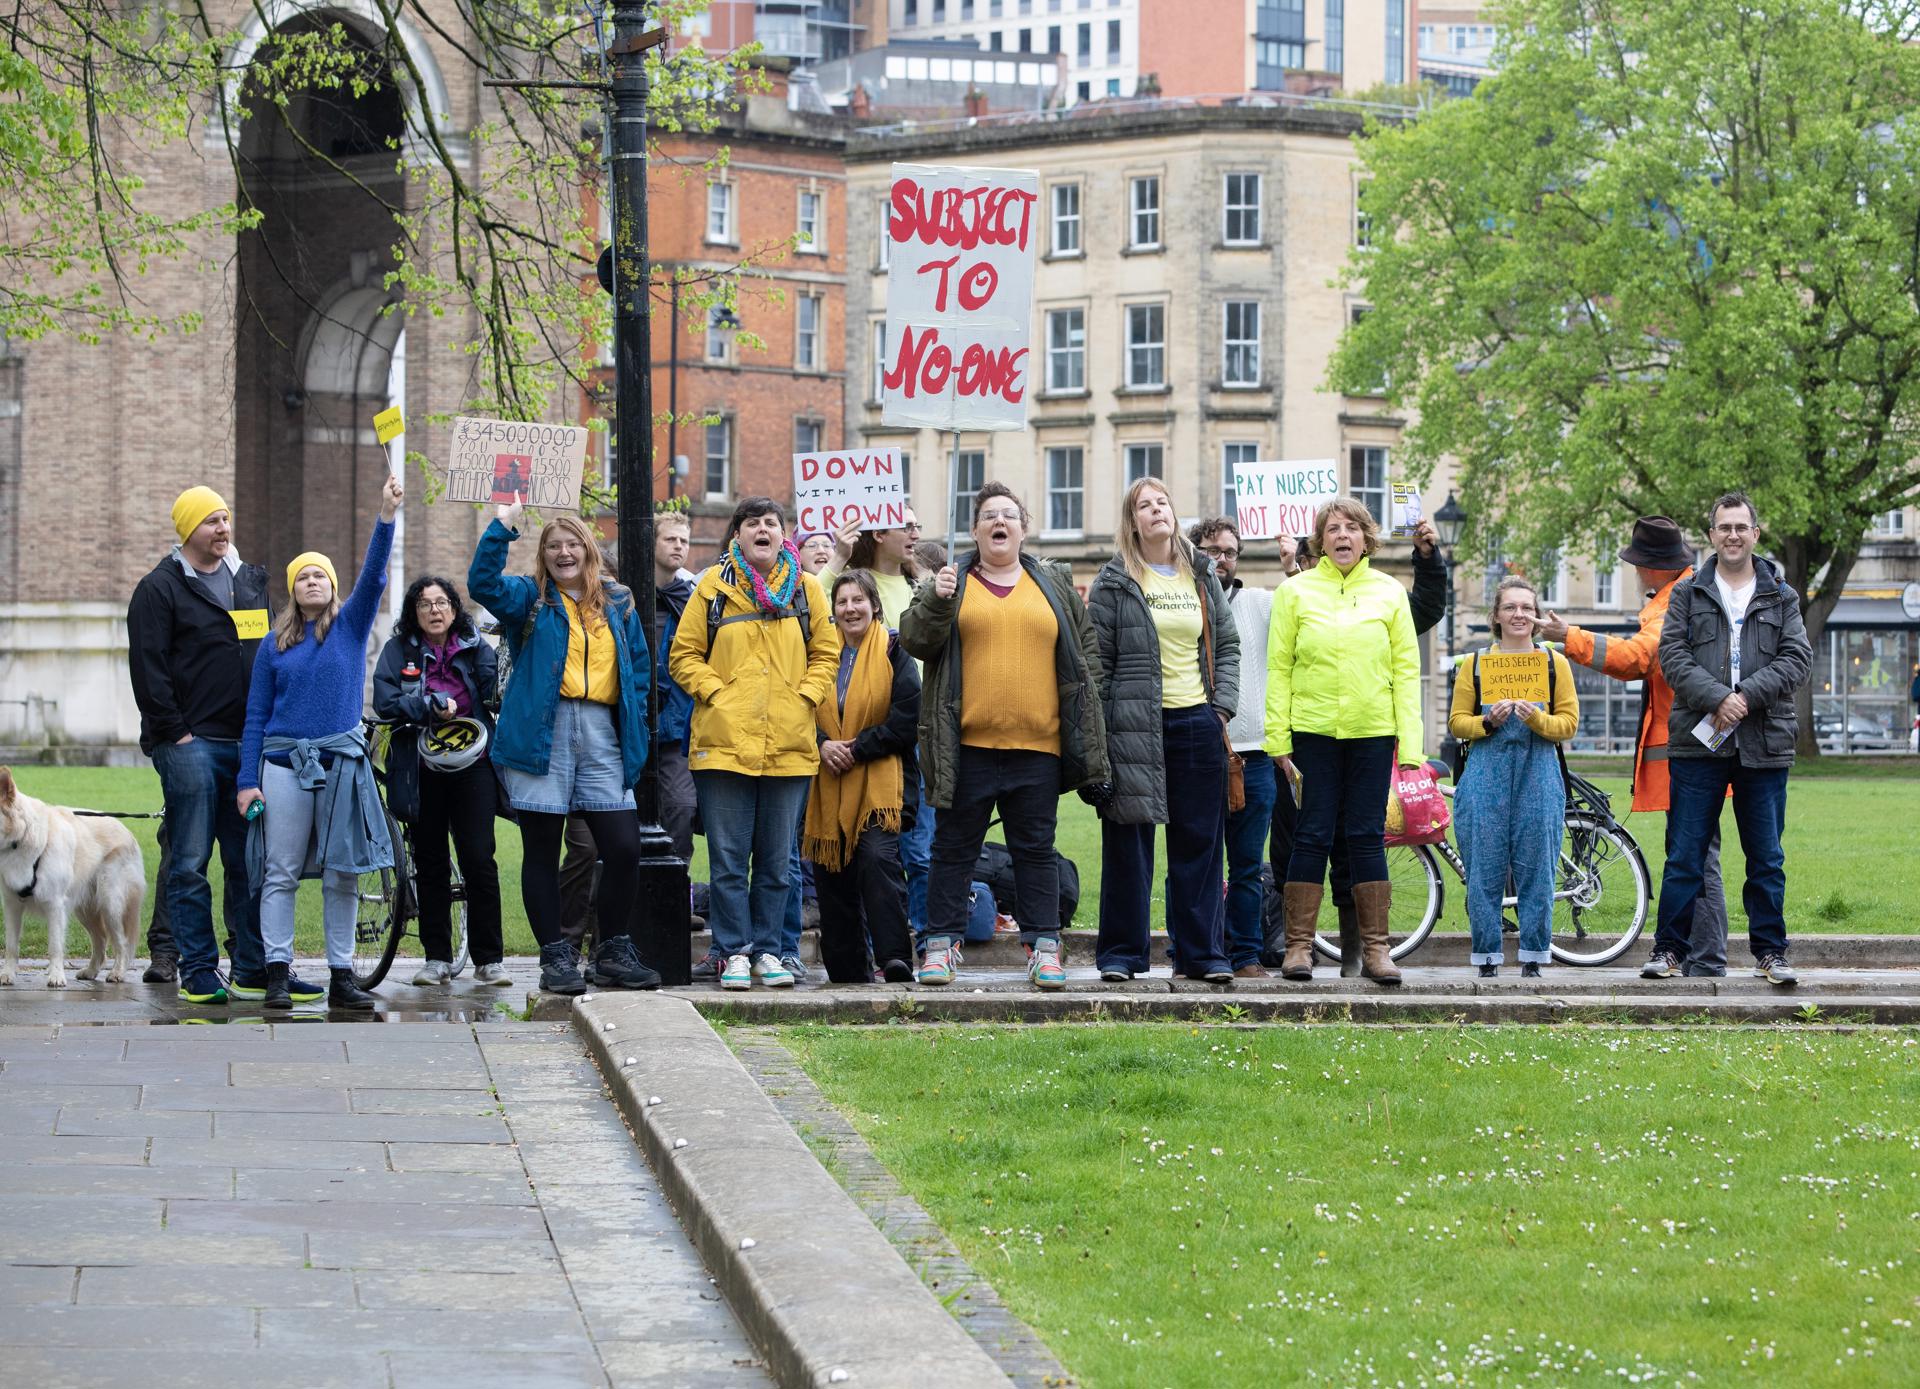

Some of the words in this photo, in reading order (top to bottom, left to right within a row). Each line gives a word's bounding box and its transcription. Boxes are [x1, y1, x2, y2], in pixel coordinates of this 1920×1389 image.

[889, 178, 1037, 252] SUBJECT
[917, 255, 998, 312] TO
[883, 324, 1029, 404] NO-ONE
[458, 418, 576, 447] £345000000
[459, 440, 488, 453] YOU
[456, 452, 494, 473] 15000
[534, 458, 571, 477] 15500
[801, 454, 893, 481] DOWN
[448, 469, 493, 501] TEACHERS
[528, 474, 571, 506] NURSES
[796, 488, 846, 498] WITH
[864, 484, 899, 494] THE
[1236, 474, 1264, 496] PAY
[1276, 469, 1338, 496] NURSES
[800, 502, 903, 532] CROWN
[1238, 506, 1267, 536] NOT
[1145, 592, 1181, 601] Abolish
[1147, 600, 1197, 611] Monarchy
[1482, 658, 1510, 668] THIS
[1512, 656, 1540, 667] SEEMS
[1490, 674, 1540, 684] SOMEWHAT
[1500, 688, 1529, 699] SILLY
